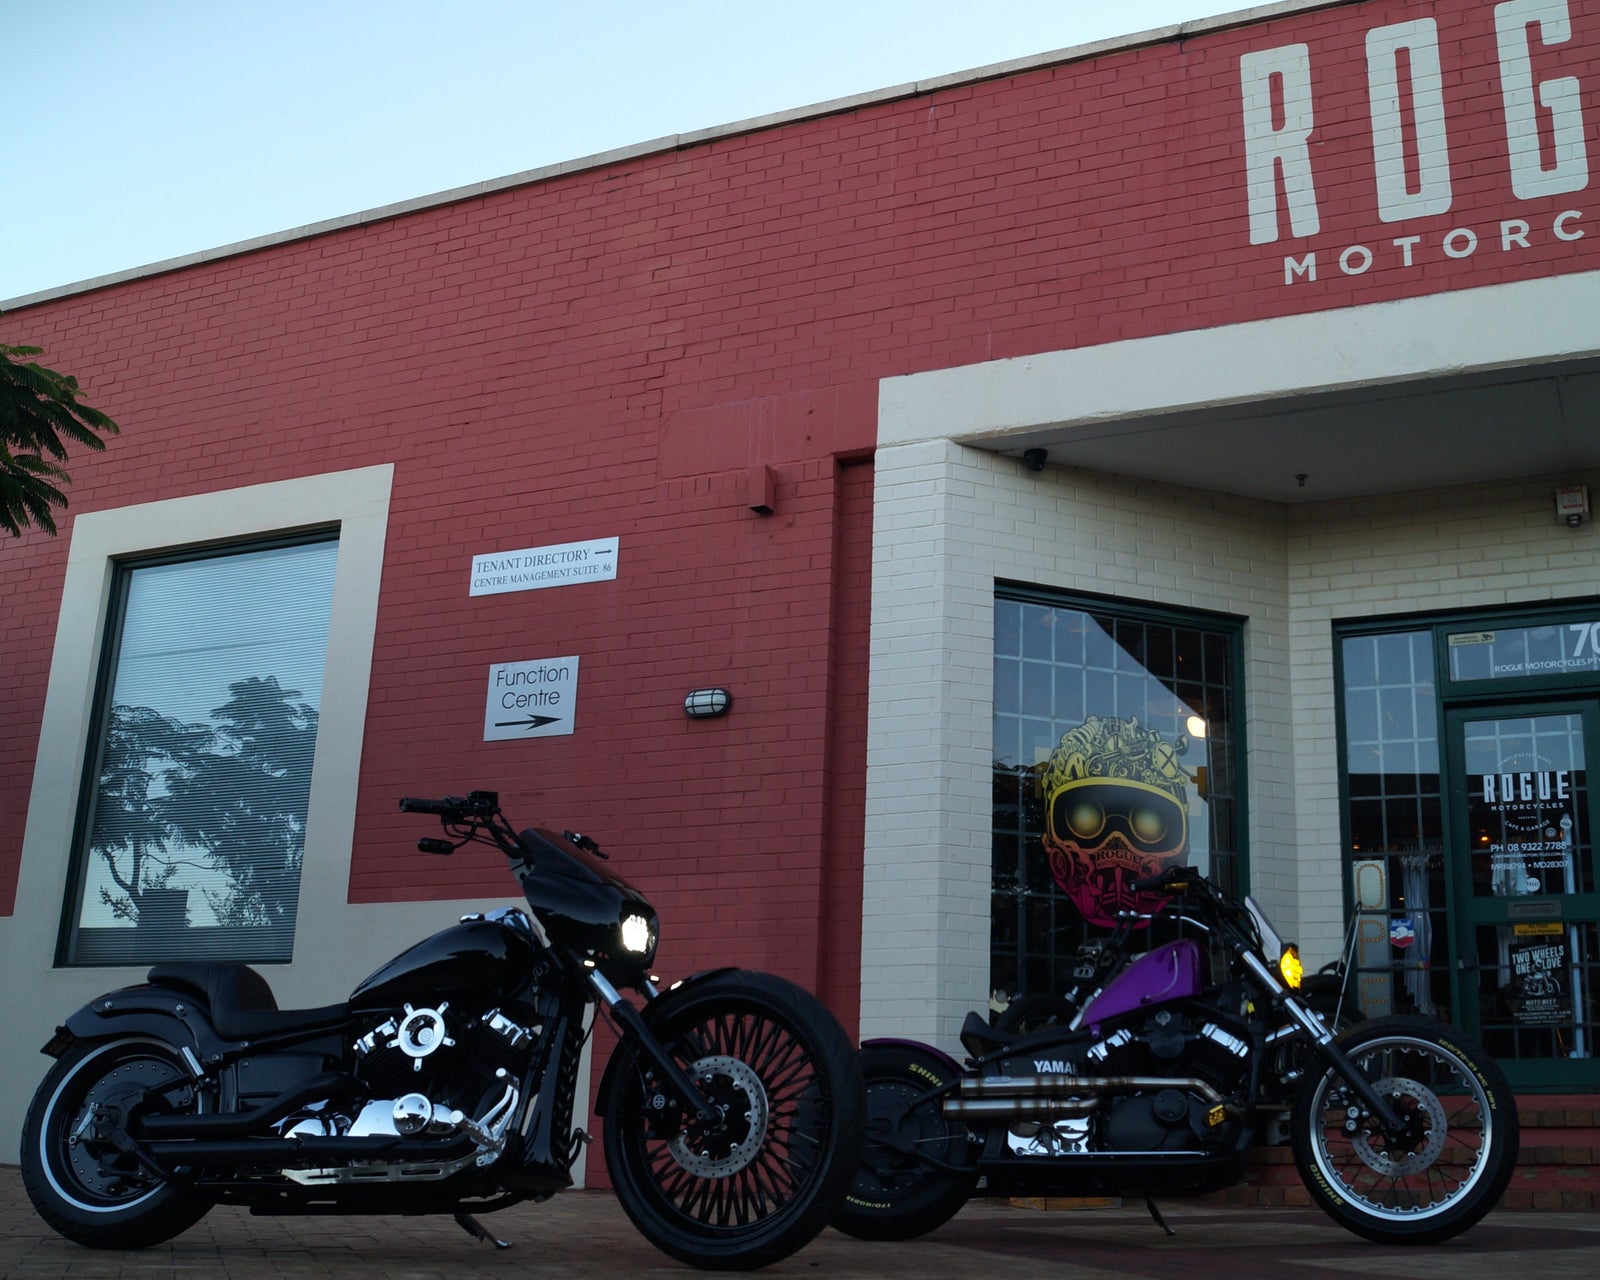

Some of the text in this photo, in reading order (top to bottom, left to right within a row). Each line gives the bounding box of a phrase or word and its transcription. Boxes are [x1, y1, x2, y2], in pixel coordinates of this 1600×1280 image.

[1284, 210, 1585, 285] MOTORC
[476, 548, 590, 573] TENANT DIRECTORY
[474, 563, 612, 588] CENTRE MANAGEMENT SUITE 86
[1494, 663, 1524, 673] ROGUE
[1525, 658, 1586, 670] MOTORCYCLES
[496, 665, 569, 688] Function
[502, 689, 560, 709] Centre
[1483, 770, 1569, 803] ROGUE
[1491, 802, 1564, 812] MOTORCYCLES
[1490, 844, 1504, 852] PH
[1507, 843, 1519, 852] 08
[1521, 842, 1543, 851] 9322
[1511, 951, 1530, 965] TWO
[1531, 945, 1564, 961] WHEELS
[1515, 957, 1562, 975] ONE LOVE
[1309, 1164, 1345, 1206] SHINKO
